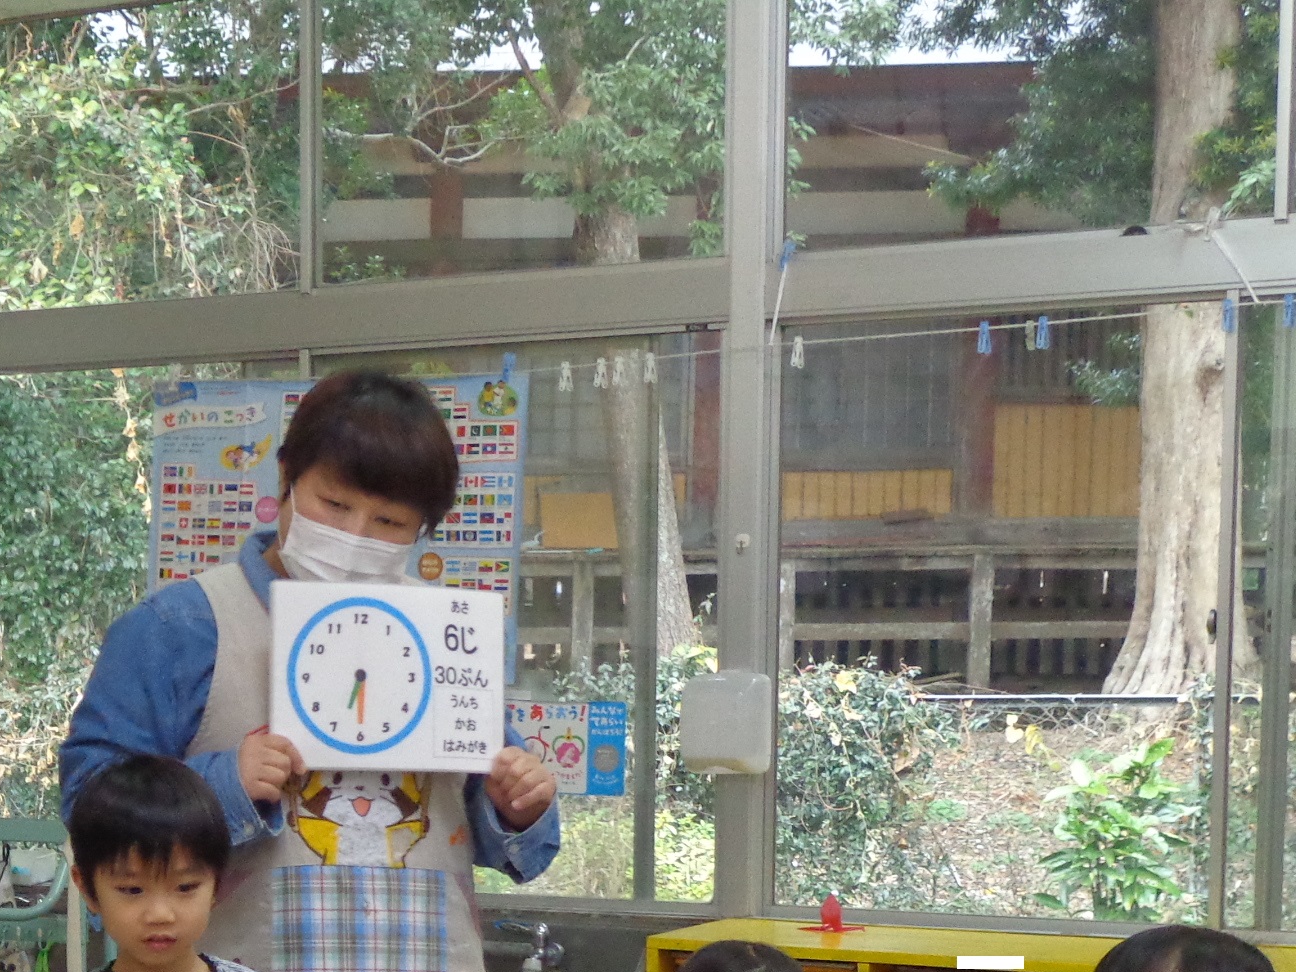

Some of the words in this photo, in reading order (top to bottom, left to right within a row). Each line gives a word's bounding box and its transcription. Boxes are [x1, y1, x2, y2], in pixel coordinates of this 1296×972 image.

[162, 406, 255, 428] せかいのこっき
[450, 600, 469, 614] あさ
[354, 613, 369, 625] 12
[328, 623, 342, 634] 11
[385, 625, 391, 636] 1
[443, 624, 478, 654] 6じ
[309, 644, 325, 655] 10
[402, 647, 411, 657] 2
[302, 673, 310, 683] 9
[407, 673, 415, 683] 3
[434, 665, 489, 688] 30ぷん
[312, 701, 320, 712] 8
[400, 702, 409, 713] 4
[450, 694, 479, 710] うんち
[329, 721, 338, 732] 7
[382, 723, 390, 733] 5
[454, 718, 477, 731] かお
[356, 731, 365, 742] 6
[443, 740, 488, 754] はみがき
